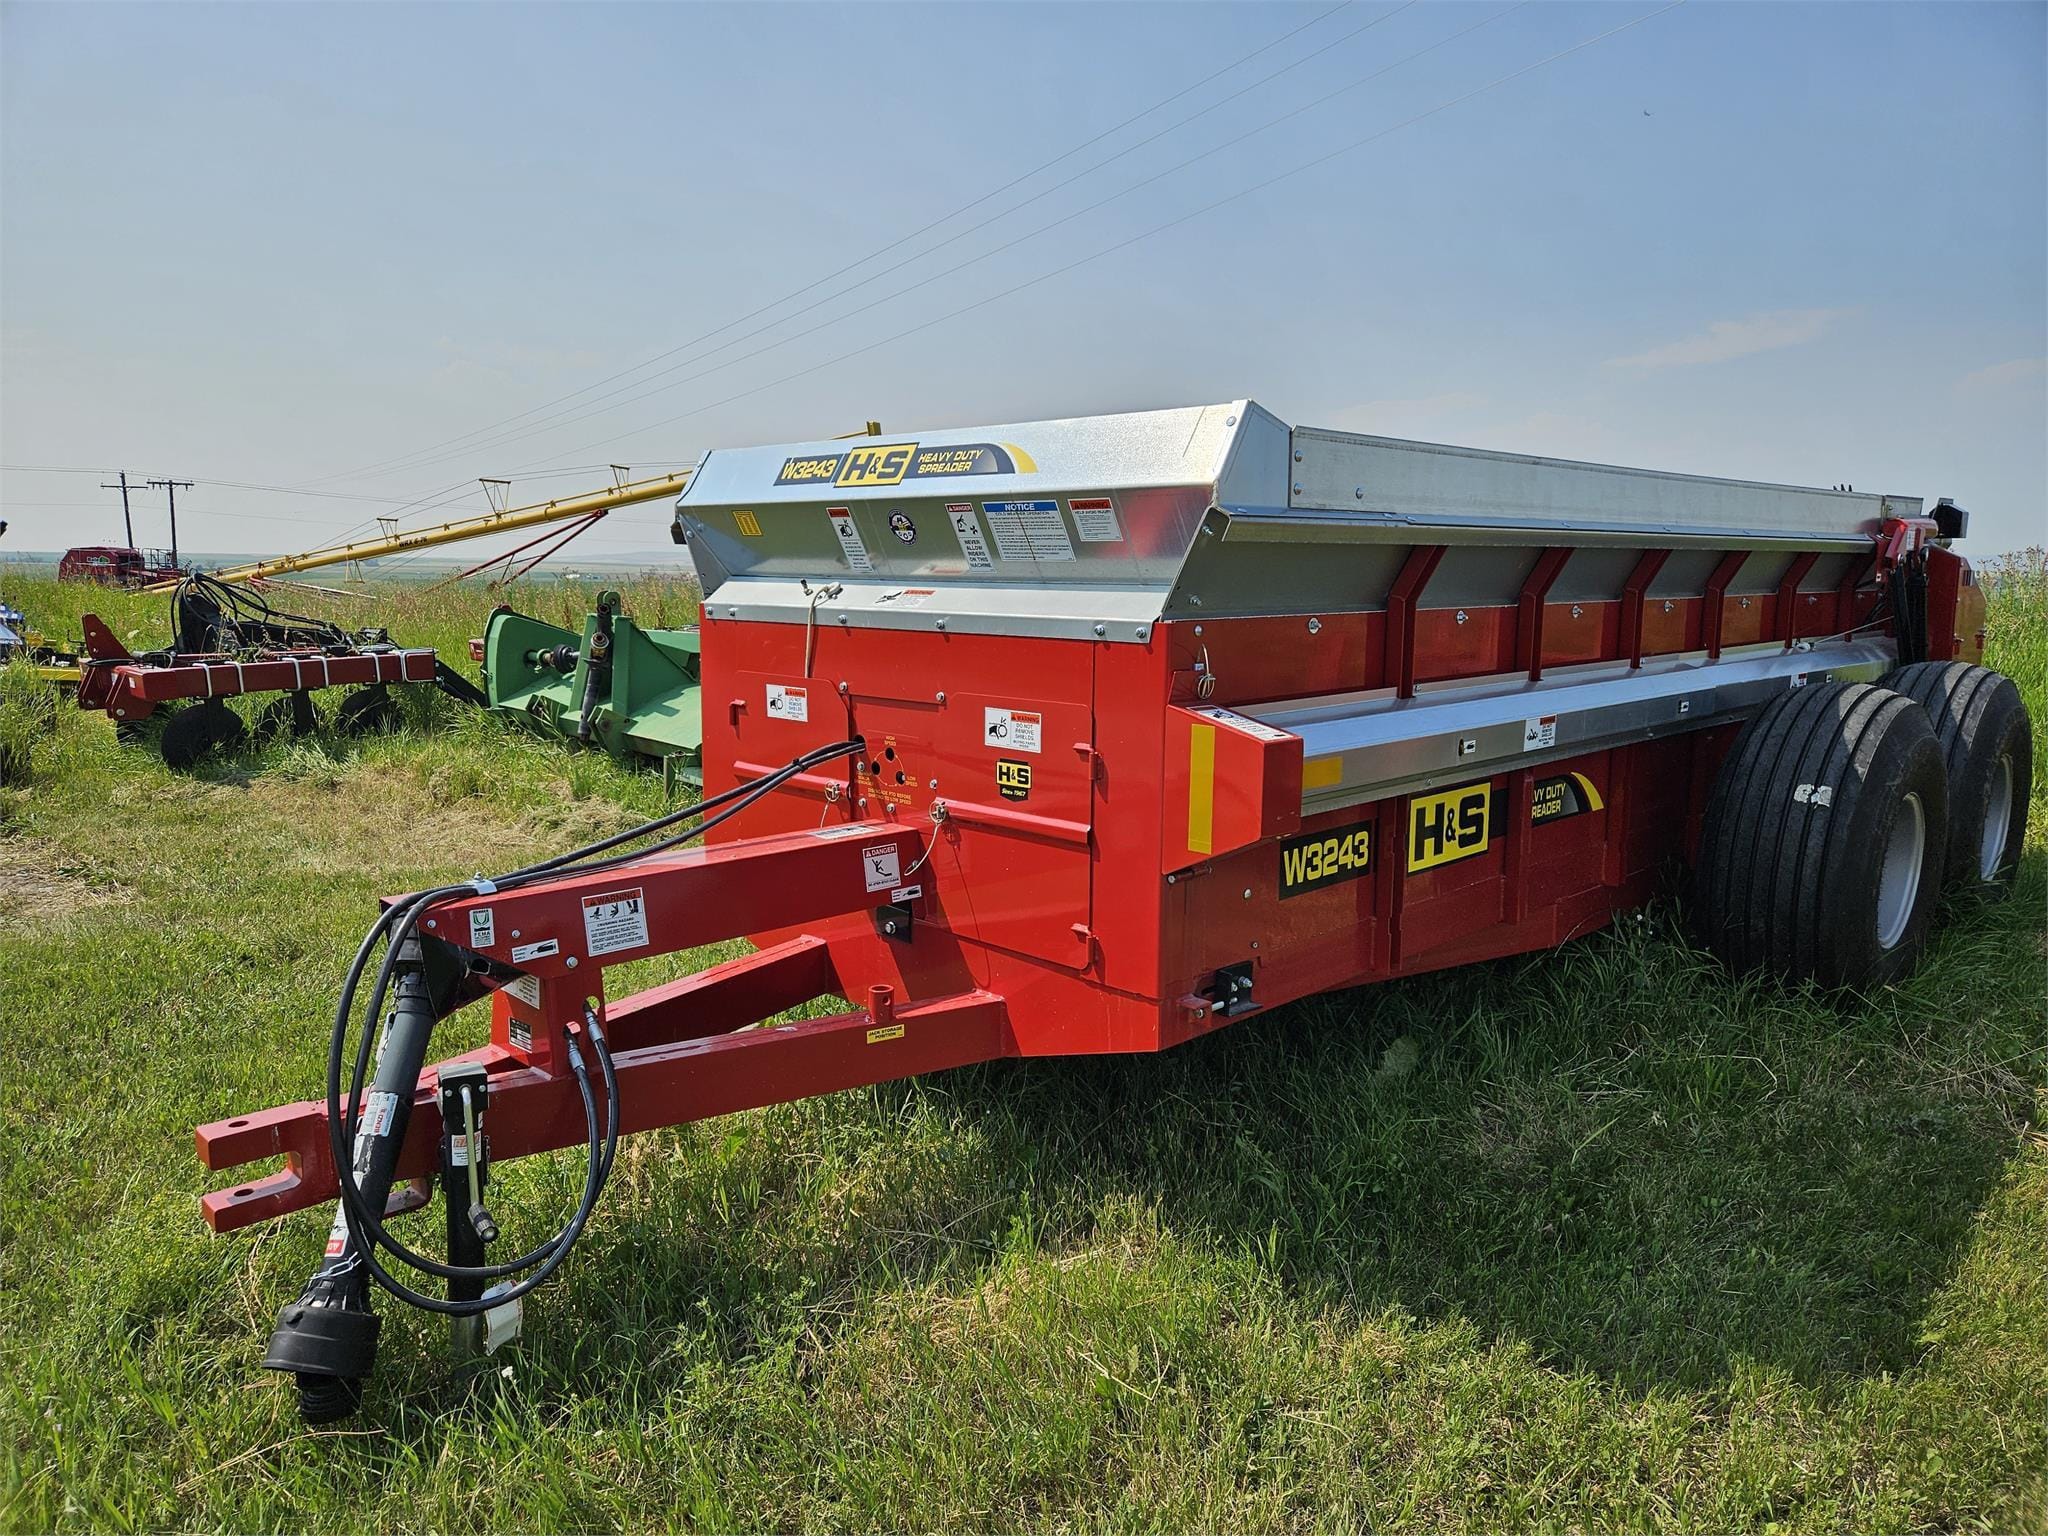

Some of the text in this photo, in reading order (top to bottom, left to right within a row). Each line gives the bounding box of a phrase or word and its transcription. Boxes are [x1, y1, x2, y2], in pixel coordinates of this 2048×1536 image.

[918, 449, 984, 464] HEAVY DUTY
[781, 449, 911, 482] W3243 H&S
[918, 461, 972, 474] SPREADER
[953, 504, 972, 512] DANGER
[1004, 503, 1035, 511] NOTICE
[1015, 714, 1040, 723] WARNING
[1015, 728, 1035, 736] REMOVE
[998, 765, 1030, 785] H&S
[1546, 783, 1567, 799] DUTY
[1414, 793, 1486, 862] H&S
[871, 846, 895, 856] DANGER
[1283, 830, 1369, 887] W3243
[598, 891, 636, 905] WARNING
